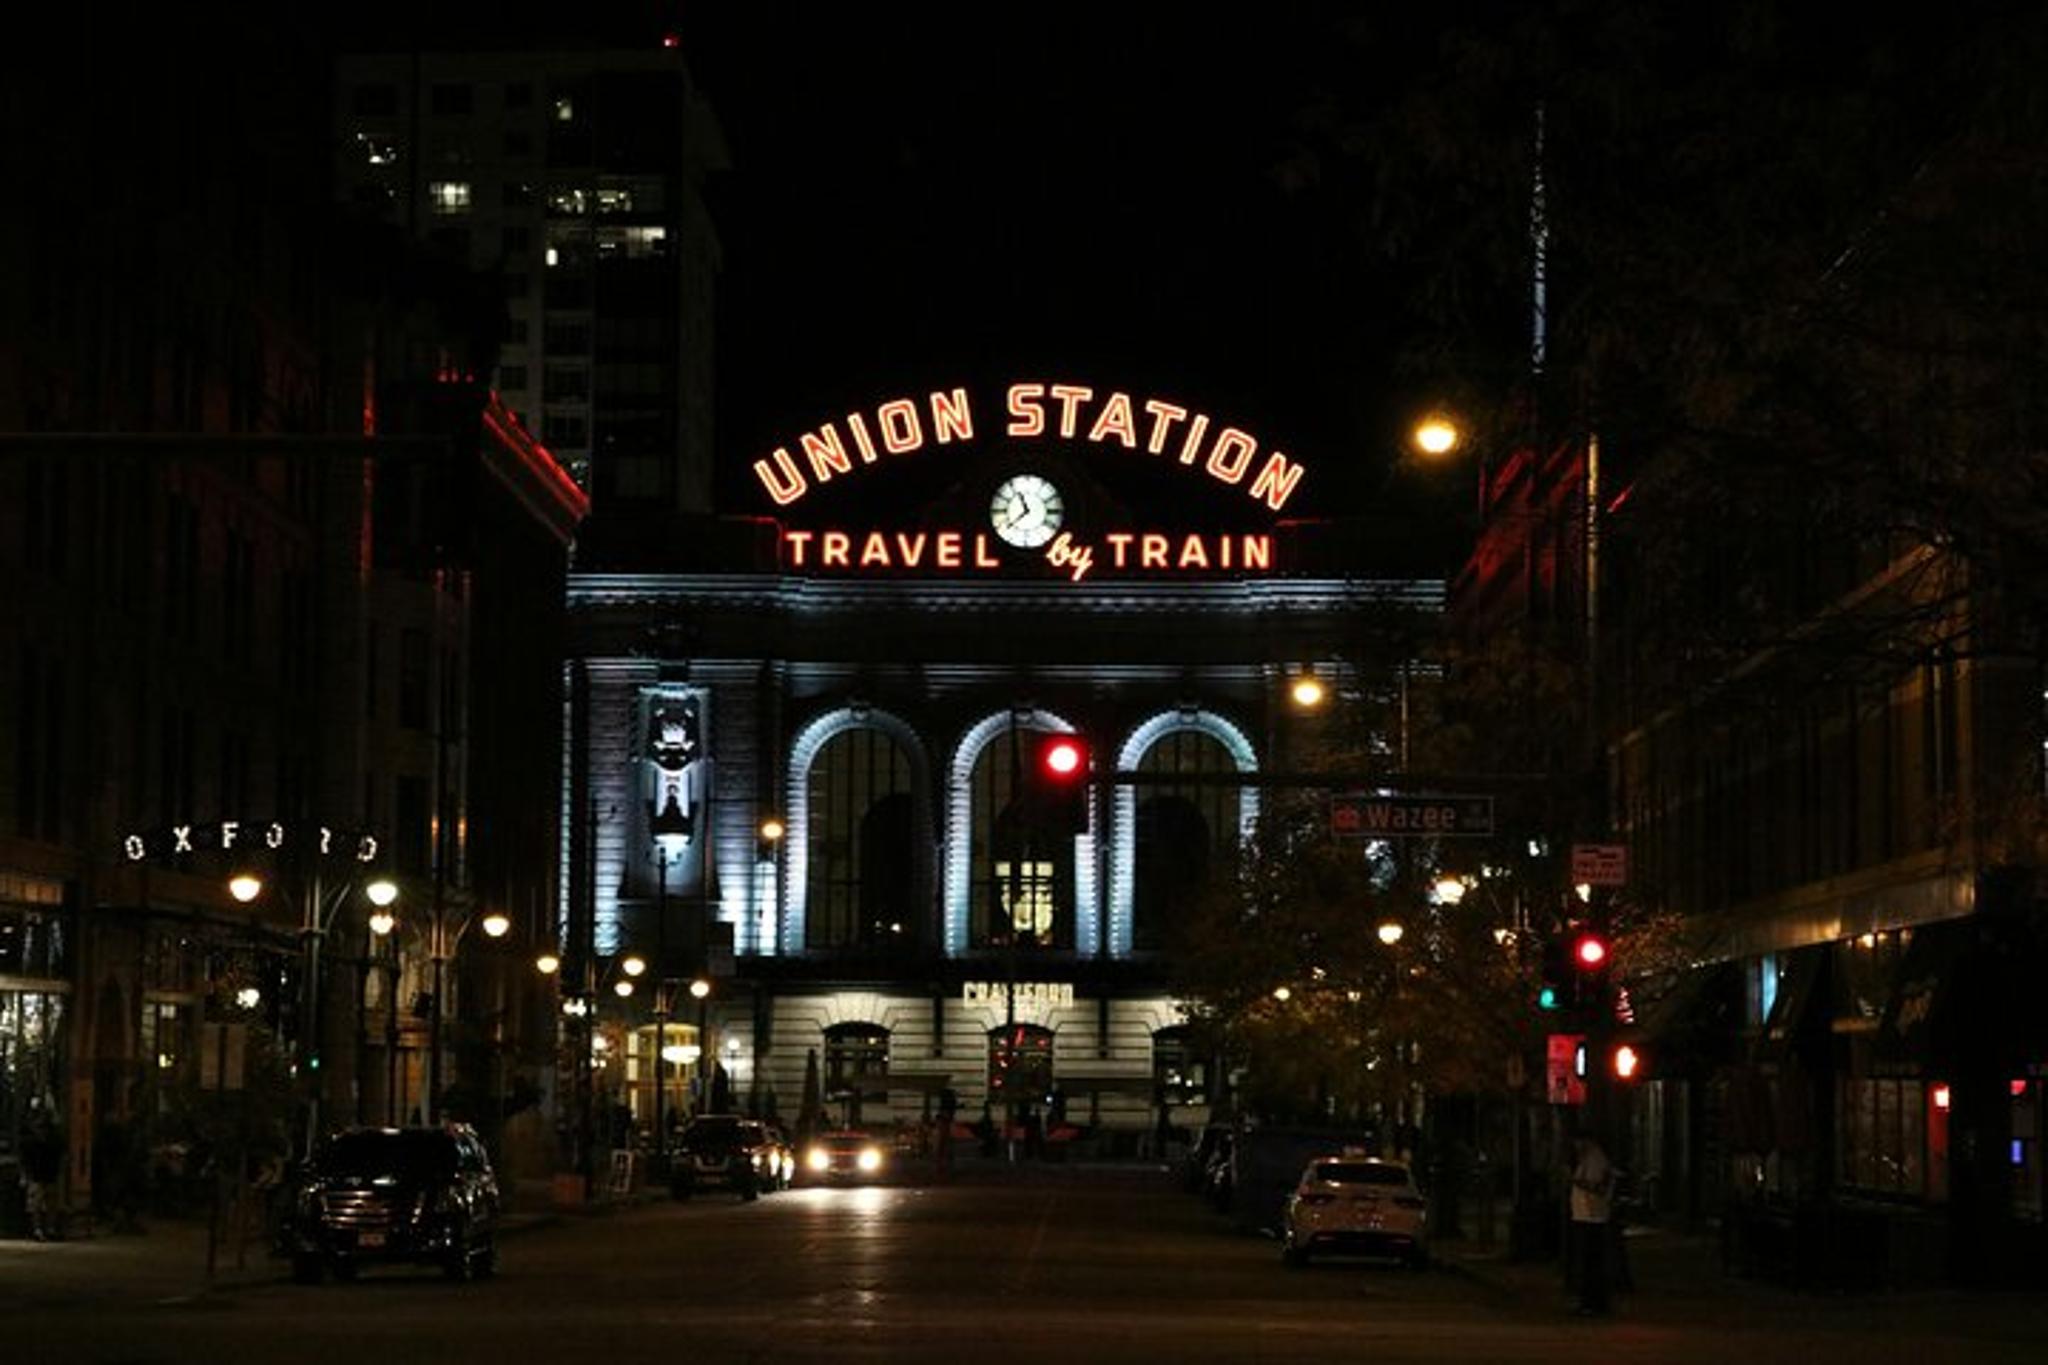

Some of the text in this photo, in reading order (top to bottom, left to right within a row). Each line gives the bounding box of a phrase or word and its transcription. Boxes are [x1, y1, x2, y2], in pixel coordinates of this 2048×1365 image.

[753, 384, 1304, 511] UNION STATION
[786, 531, 1270, 581] TRAVEL by TRAIN
[1367, 803, 1457, 829] Wazee
